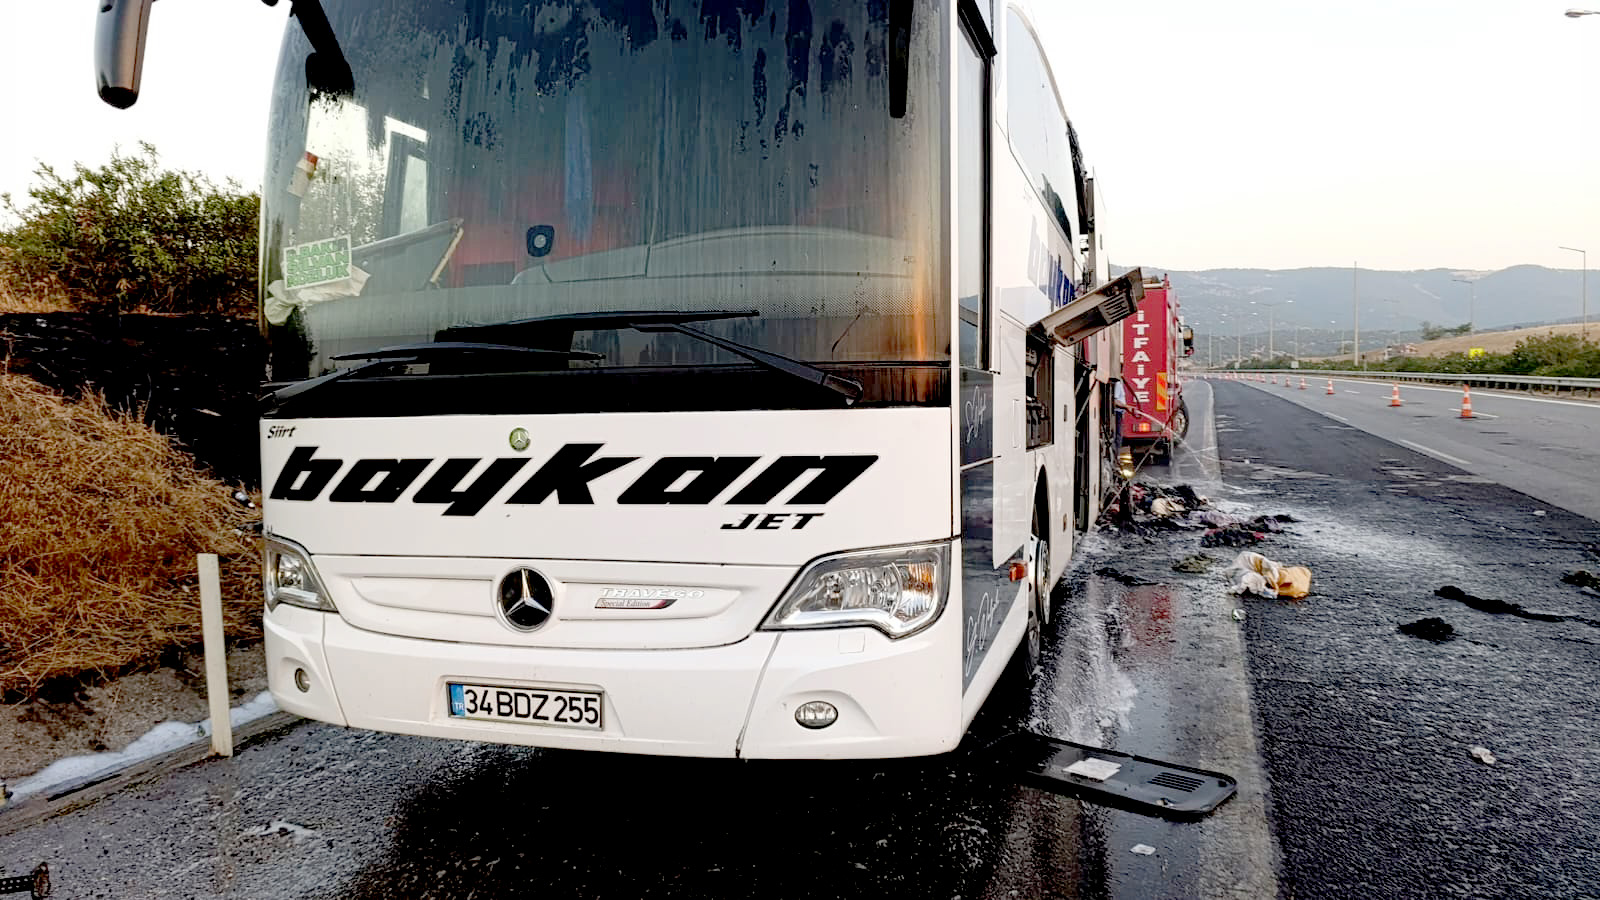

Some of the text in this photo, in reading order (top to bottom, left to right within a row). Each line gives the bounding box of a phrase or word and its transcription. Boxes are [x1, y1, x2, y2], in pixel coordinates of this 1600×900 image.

[267, 425, 297, 439] Siirt
[269, 442, 879, 517] baykan
[720, 512, 825, 530] JET
[599, 587, 705, 599] TRAVEGO
[600, 600, 651, 609] Special Edition
[465, 689, 493, 715] 34
[496, 691, 550, 721] BDZ
[554, 695, 599, 724] 255
